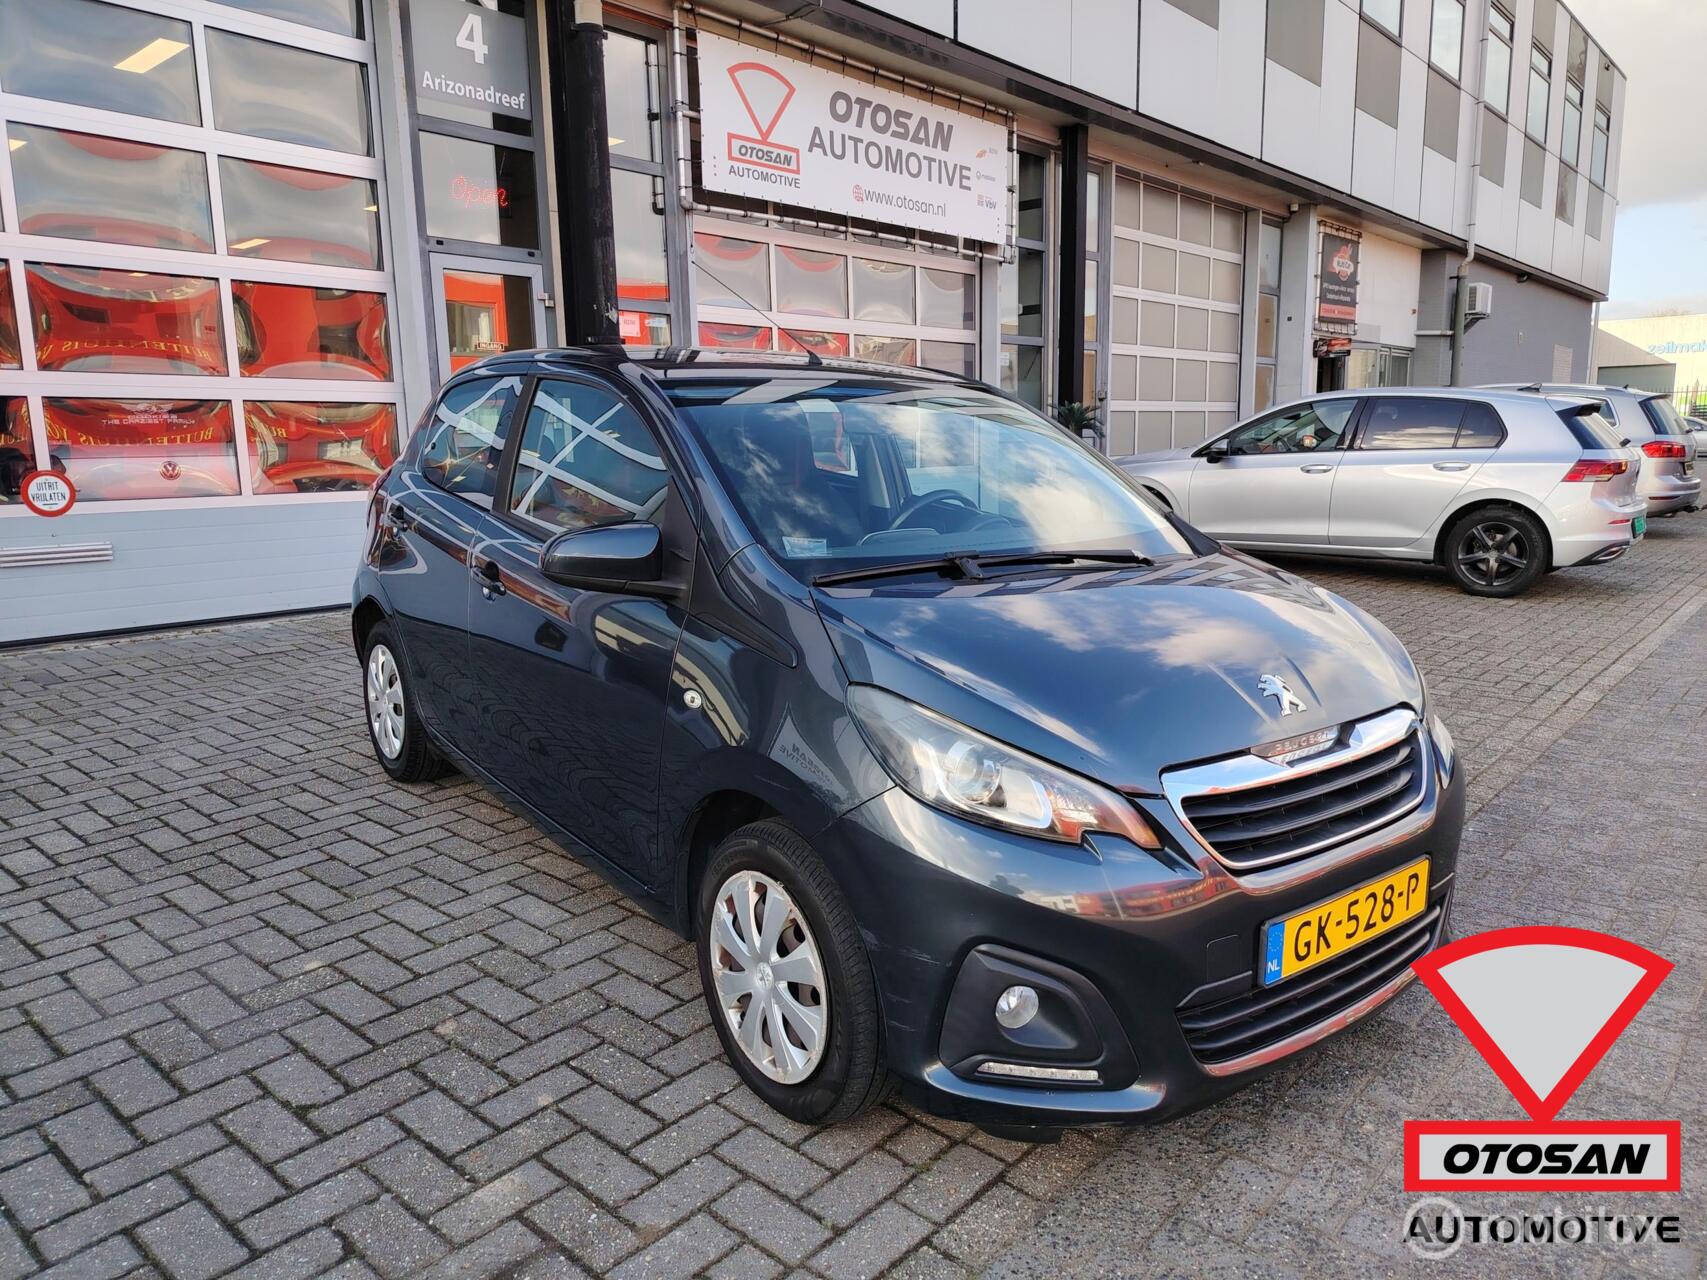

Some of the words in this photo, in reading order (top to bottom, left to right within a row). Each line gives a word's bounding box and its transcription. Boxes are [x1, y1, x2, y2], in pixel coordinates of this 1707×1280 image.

[455, 12, 489, 65] 4
[422, 70, 526, 111] Arizonadreef
[829, 90, 954, 152] OTOSAN
[738, 143, 793, 167] OTOSAN
[807, 125, 972, 192] AUTOMOTIVE
[728, 164, 801, 189] AUTOMOTIVE
[864, 187, 947, 218] www.otosan.nl
[36, 481, 58, 492] UITRIT
[1294, 872, 1420, 962] GK-528-P
[1267, 959, 1280, 974] NL
